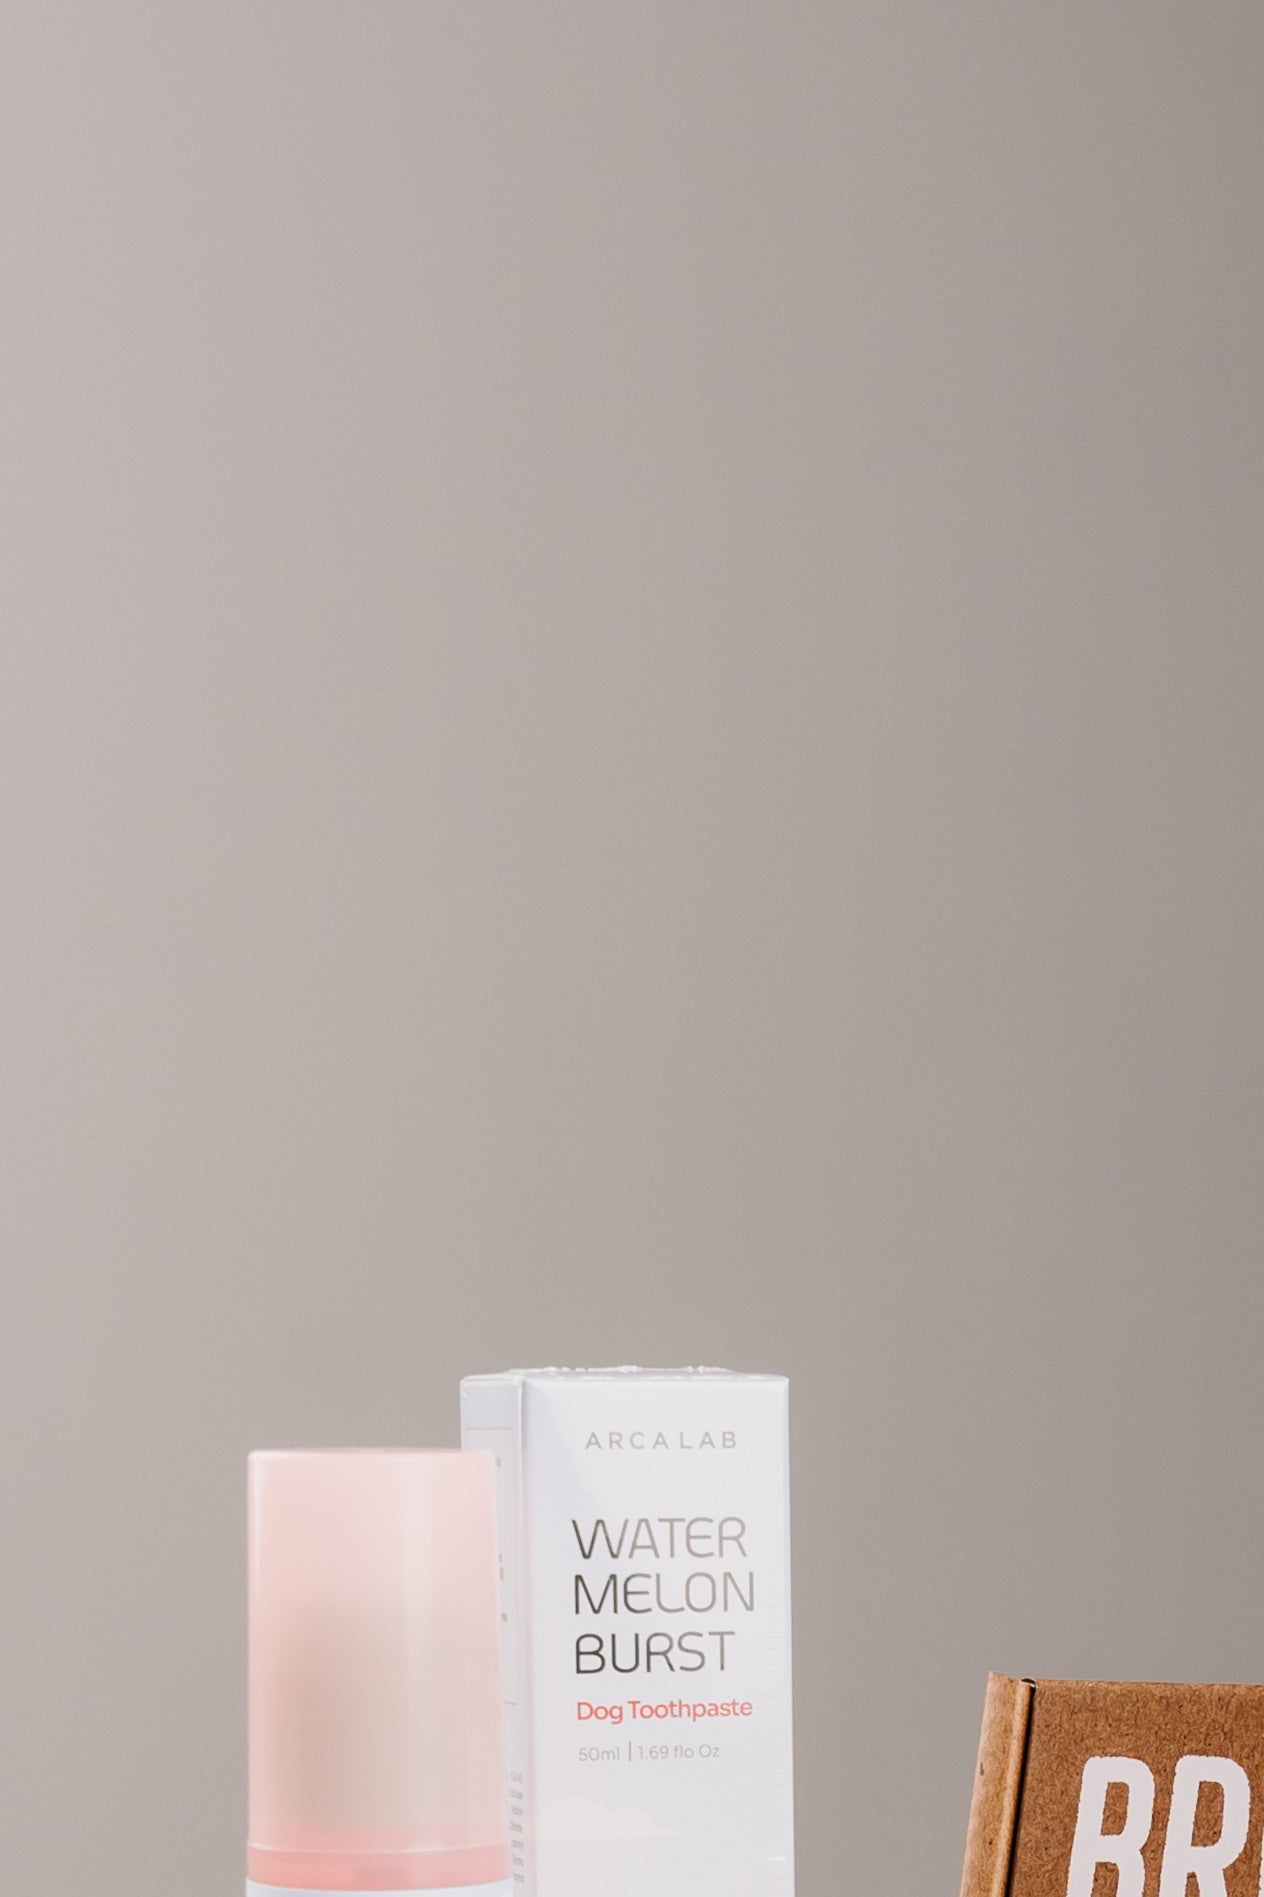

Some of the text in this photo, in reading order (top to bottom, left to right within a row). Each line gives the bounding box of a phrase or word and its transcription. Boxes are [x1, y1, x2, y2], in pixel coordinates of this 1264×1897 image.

[571, 1517, 747, 1559] WATER
[574, 1572, 755, 1615] MELON
[575, 1631, 736, 1674] BURST
[577, 1699, 753, 1725] Dog Toothpaste
[578, 1746, 621, 1762] 50ml
[637, 1745, 670, 1760] 1.69
